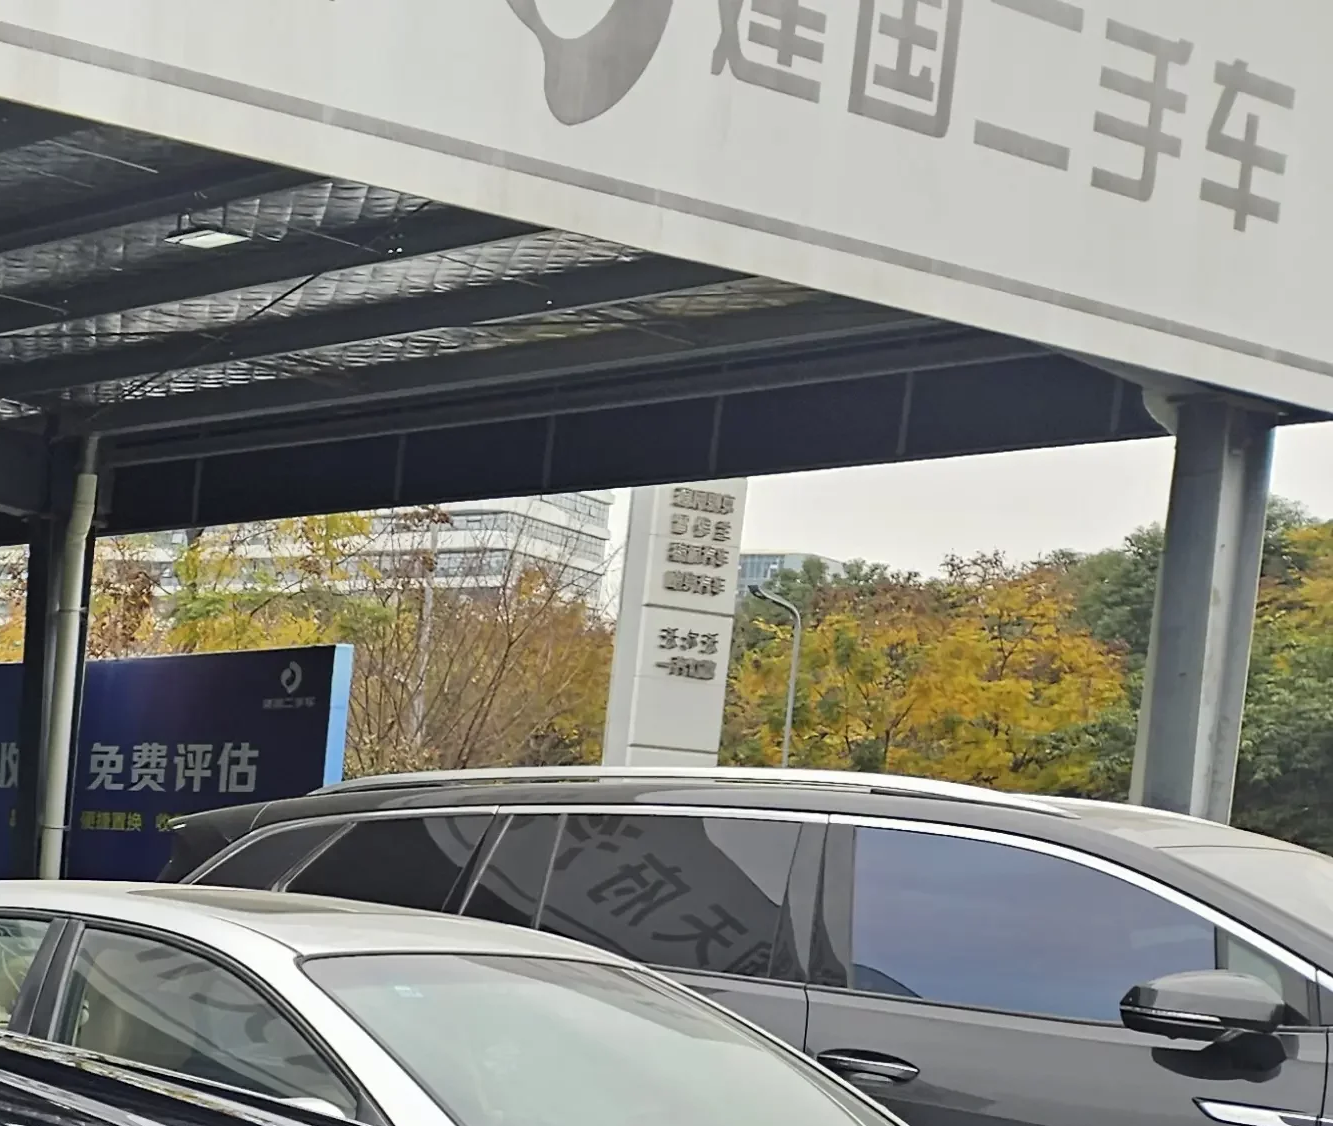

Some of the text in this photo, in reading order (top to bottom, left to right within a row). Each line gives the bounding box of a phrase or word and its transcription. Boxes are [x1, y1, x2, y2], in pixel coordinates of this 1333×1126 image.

[711, 0, 1295, 232] 建国二手车
[86, 742, 259, 792] 免费评估
